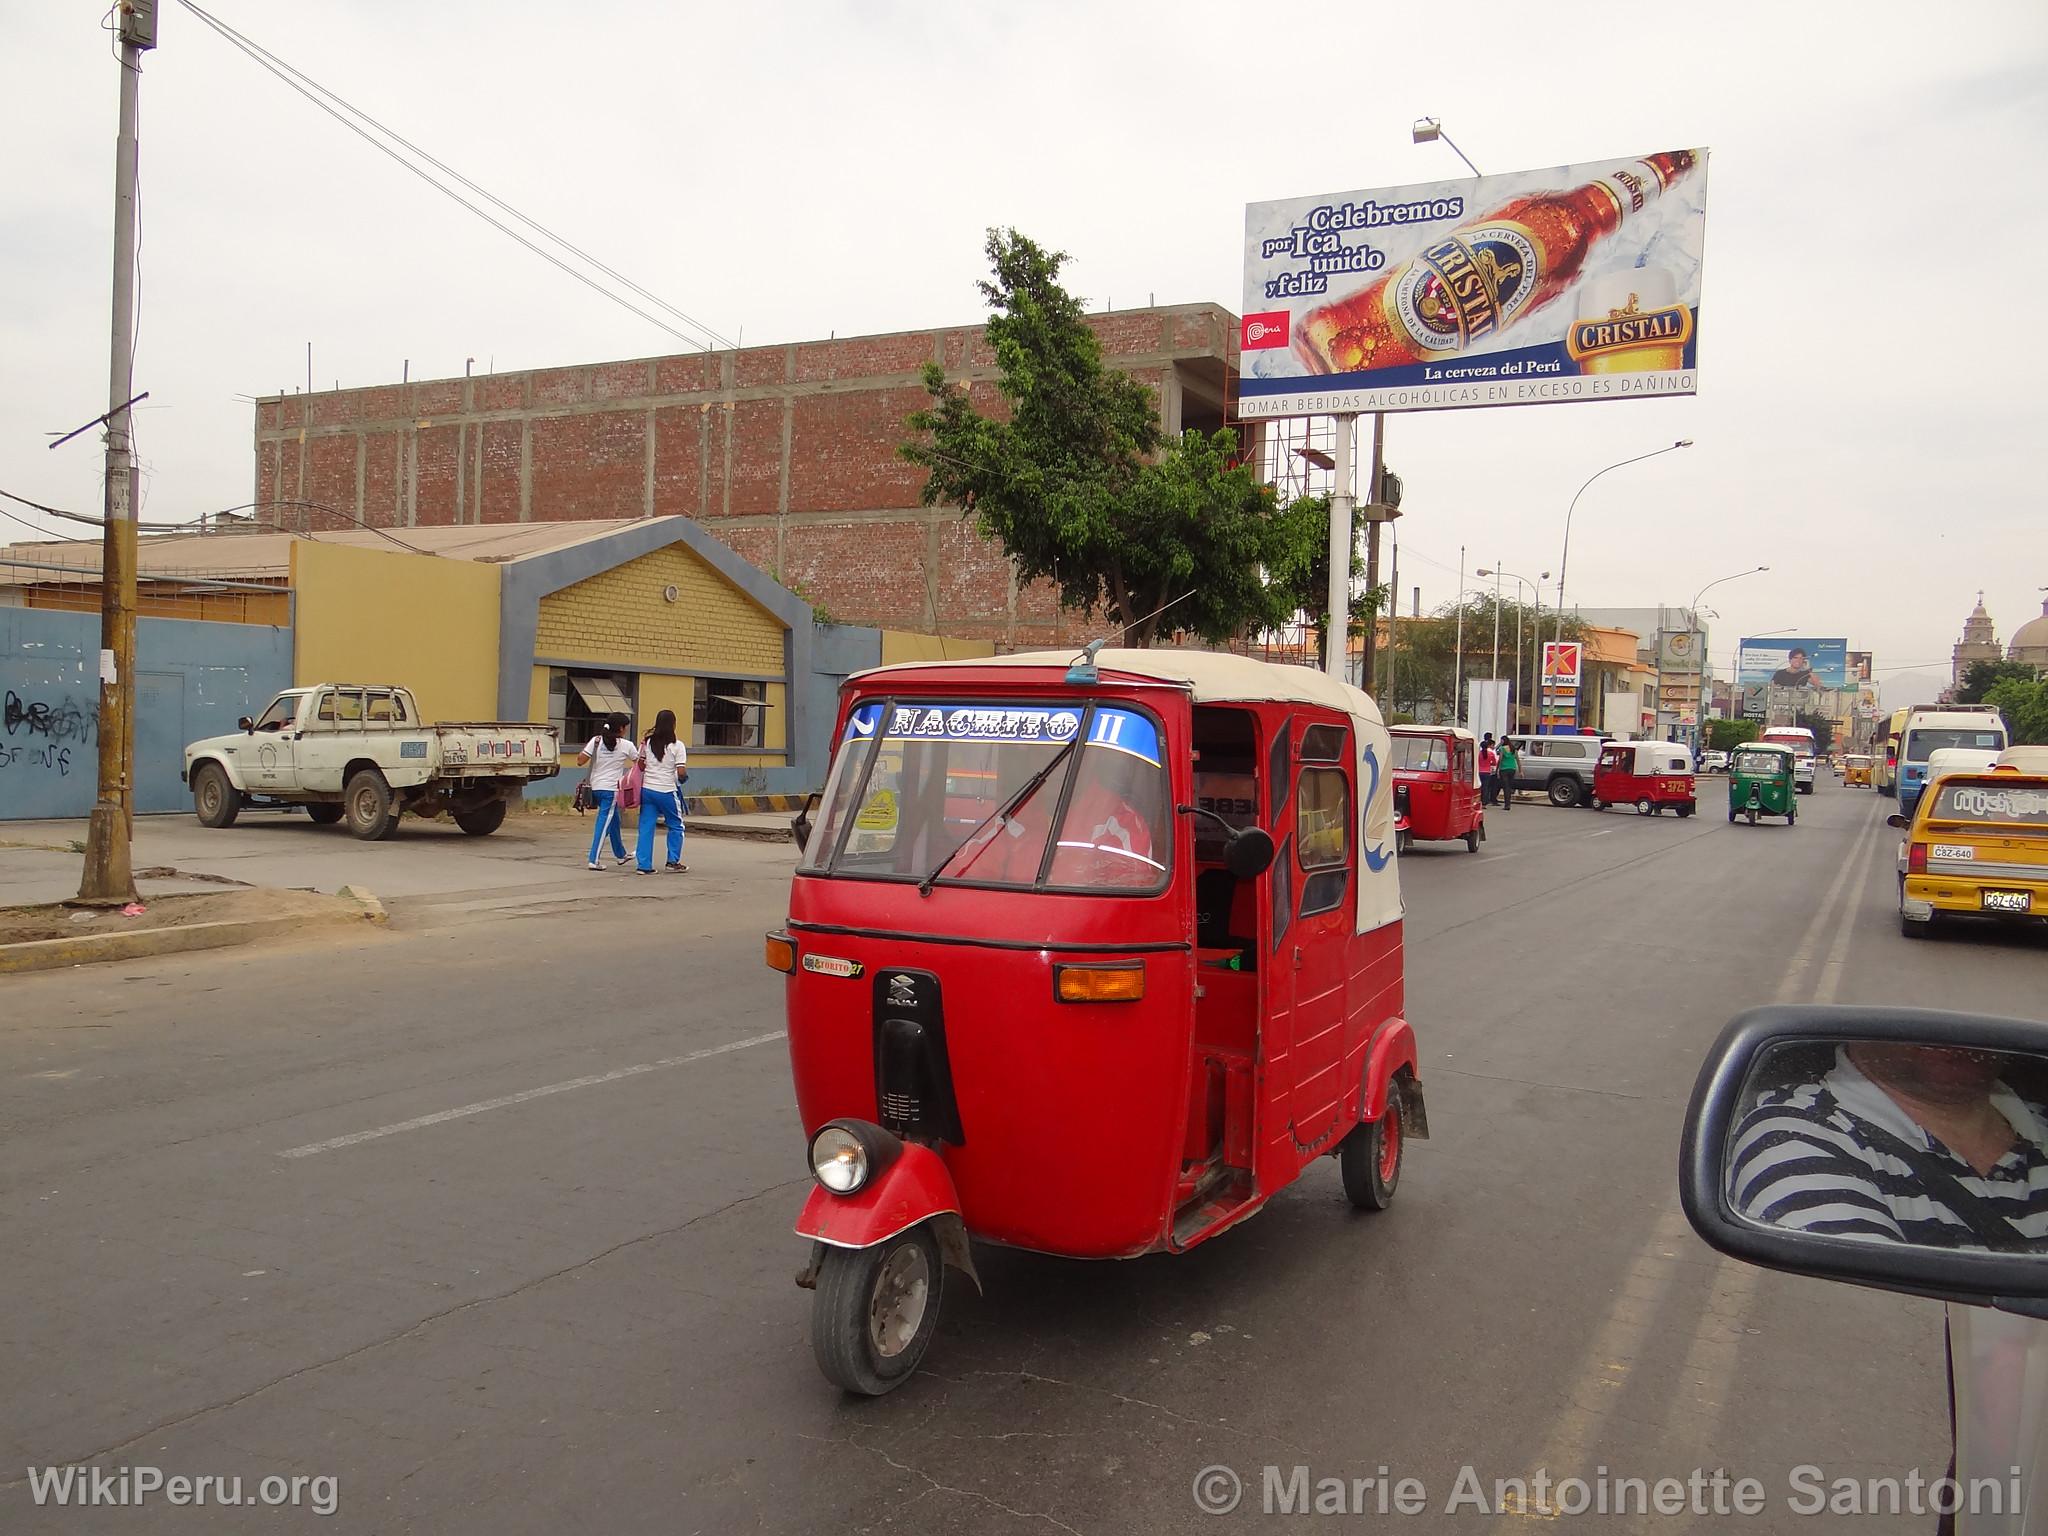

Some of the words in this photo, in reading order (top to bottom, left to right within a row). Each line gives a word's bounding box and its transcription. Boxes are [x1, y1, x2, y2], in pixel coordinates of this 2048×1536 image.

[1611, 169, 1644, 214] CRISTAL
[1310, 198, 1462, 231] Celebremos
[1264, 239, 1292, 257] por
[1292, 229, 1340, 257] Ica
[1489, 231, 1530, 258] CERVEZA
[1526, 259, 1535, 278] DEL
[1311, 246, 1384, 274] unido
[1266, 281, 1276, 296] y
[1277, 273, 1327, 296] feliz
[1427, 241, 1494, 342] CRISTAL
[1415, 328, 1425, 338] LA
[1424, 335, 1454, 346] CALIDAD
[1581, 315, 1678, 348] CRISTAL
[1424, 367, 1442, 380] La
[1445, 367, 1497, 379] cerveza
[1500, 363, 1523, 376] del
[1526, 360, 1561, 374] Perú
[1239, 400, 1289, 415] TOMAR
[1297, 395, 1360, 411] BEBIDAS
[1368, 387, 1479, 406] ALCOHÓLICAS
[1488, 386, 1508, 399] EN
[1518, 382, 1583, 398] EXCESO
[1592, 379, 1610, 394] ES
[1622, 375, 1695, 392] DAÑINO.
[889, 708, 1078, 741] NACHITO
[1093, 713, 1126, 745] II
[1934, 848, 1972, 859] C8Z-640
[1985, 894, 2028, 909] C8Z-640
[820, 960, 849, 972] TORITO
